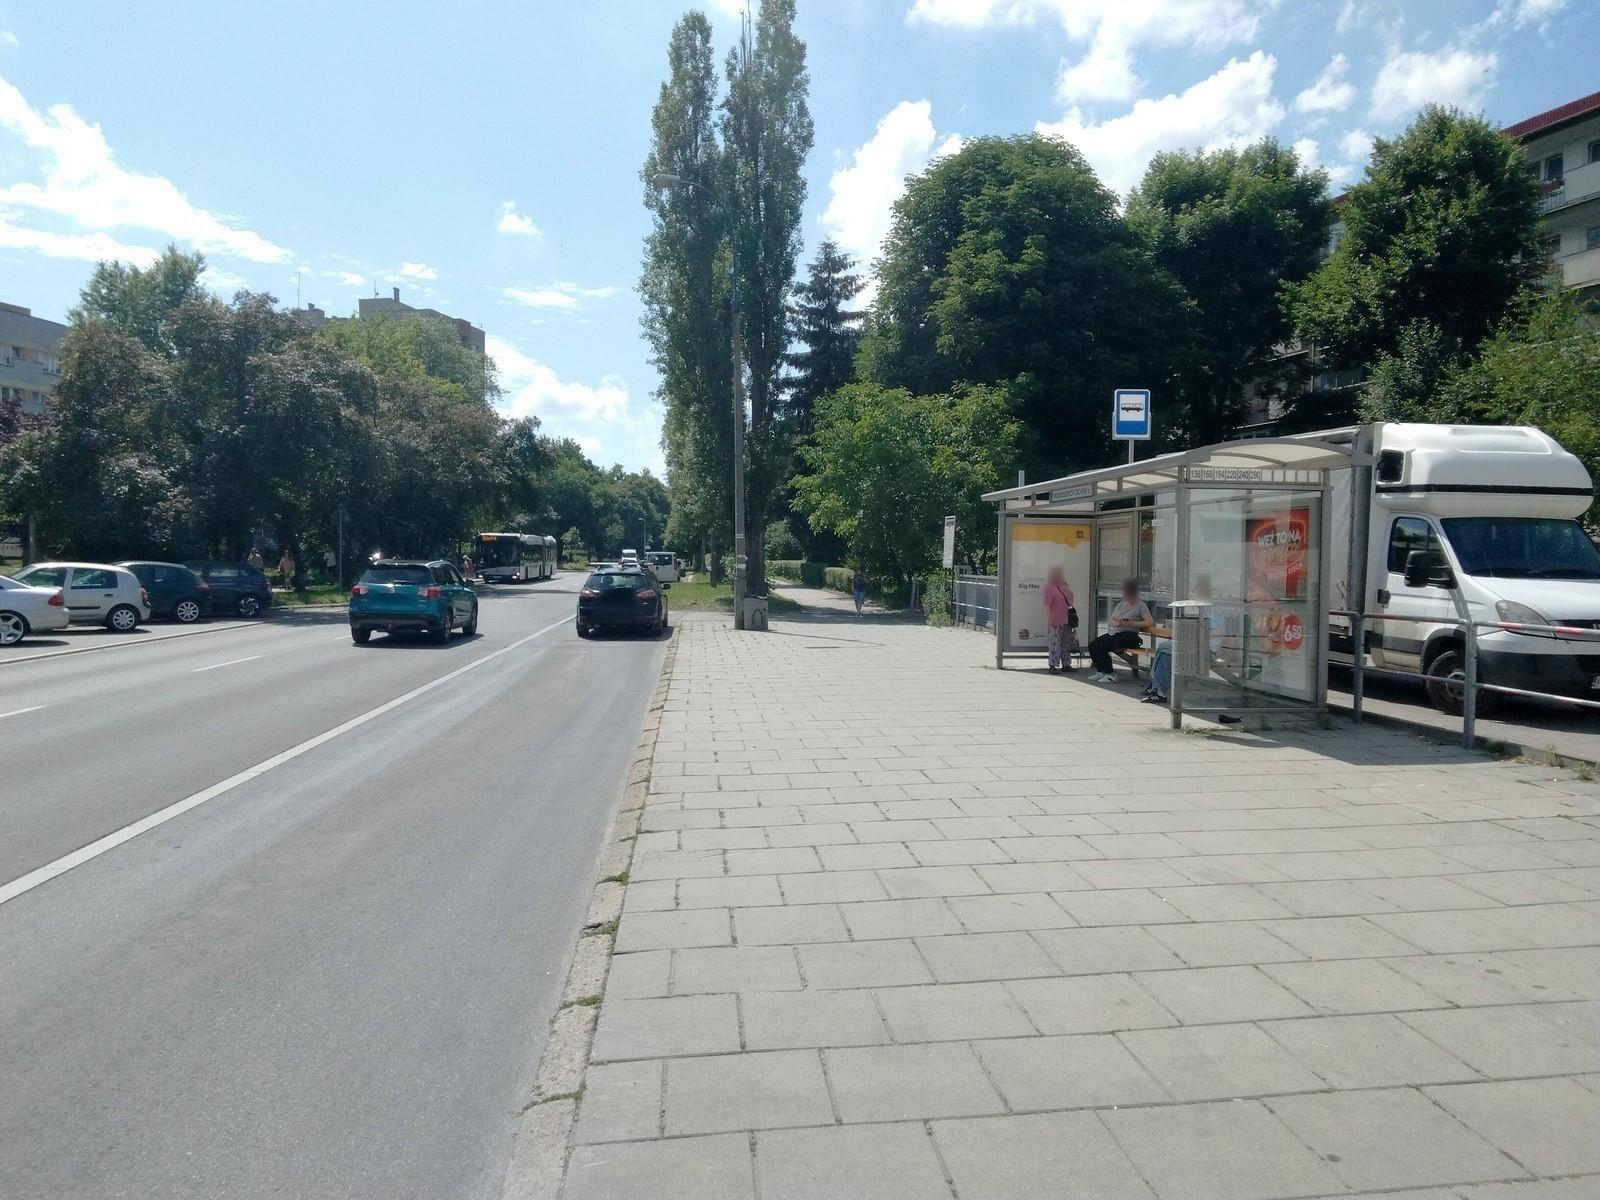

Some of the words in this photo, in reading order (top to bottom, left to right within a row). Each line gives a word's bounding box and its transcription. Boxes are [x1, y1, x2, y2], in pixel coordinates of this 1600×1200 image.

[1191, 470, 1201, 479] 138
[1203, 470, 1213, 479] 168
[1215, 470, 1225, 479] 194
[1226, 470, 1237, 479] 220
[1238, 470, 1249, 479] 240
[1250, 471, 1260, 479] 290
[1276, 531, 1288, 544] TO
[1288, 529, 1301, 543] NA
